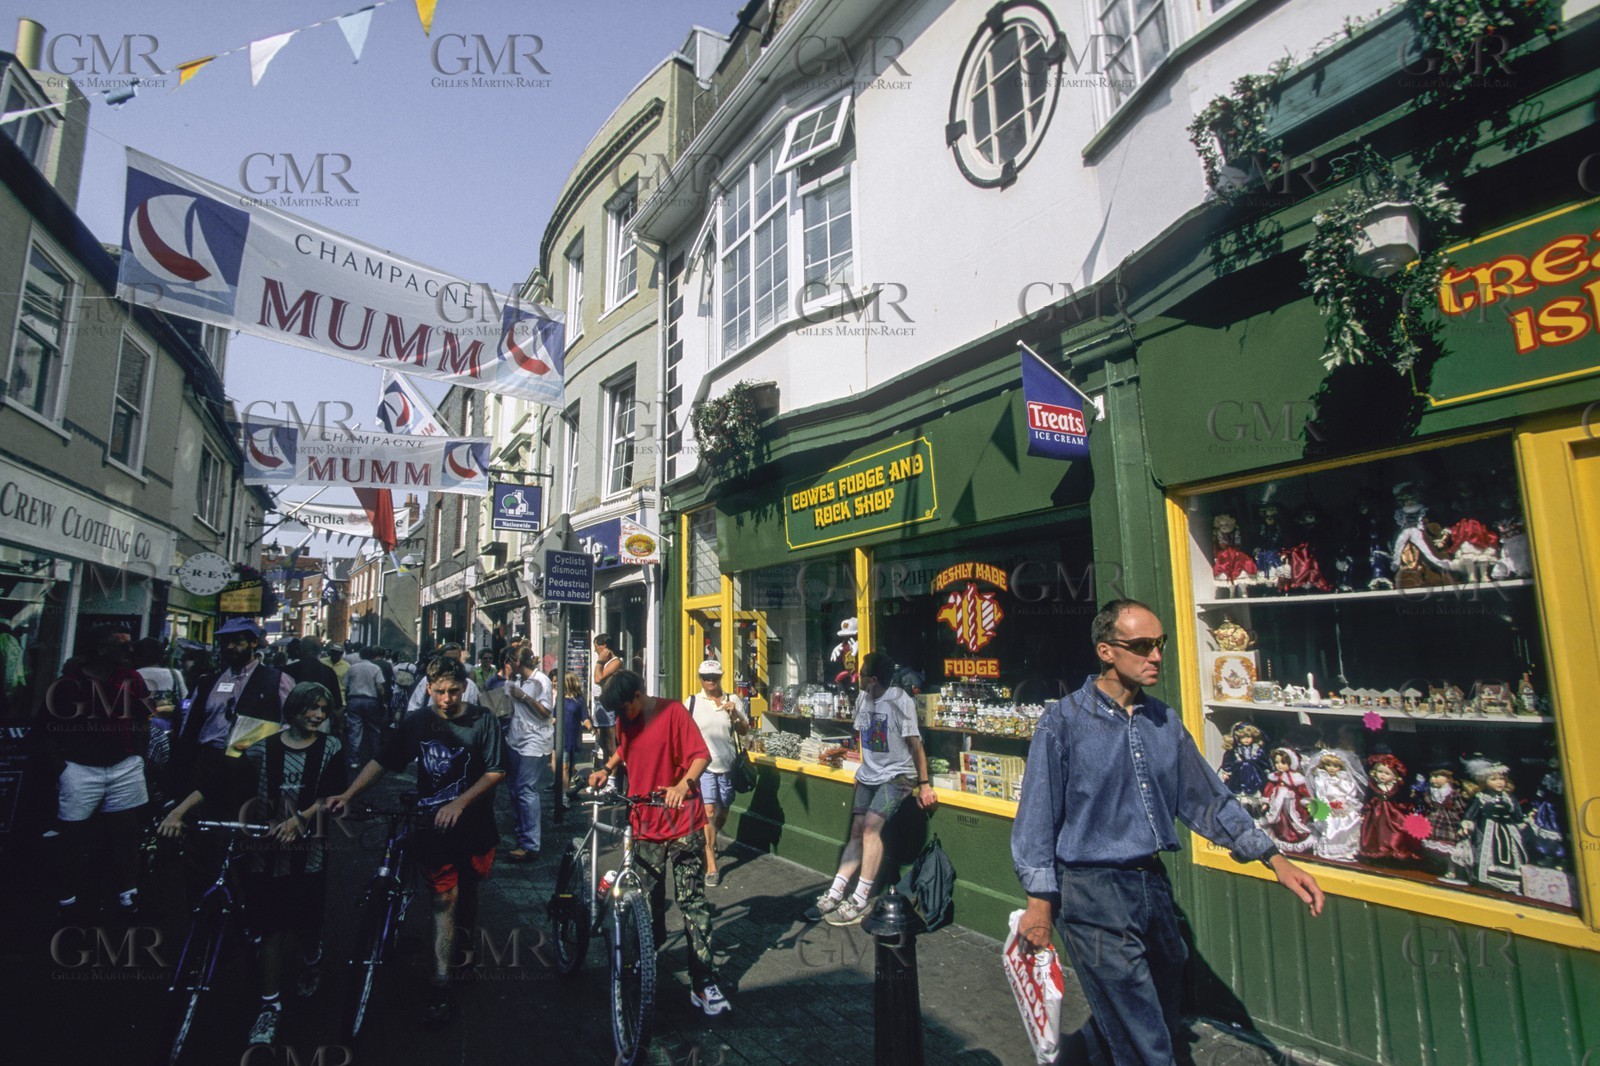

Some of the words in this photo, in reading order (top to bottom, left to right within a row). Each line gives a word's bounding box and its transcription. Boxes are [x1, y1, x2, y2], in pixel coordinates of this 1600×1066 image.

[295, 233, 475, 309] CHAMPAGNE
[256, 276, 486, 379] MUMM
[1029, 404, 1084, 433] Treats
[320, 431, 426, 449] CHAMPAGNE
[1035, 431, 1051, 441] ICE
[1054, 434, 1084, 445] CREAM
[307, 456, 432, 487] MUMM
[791, 482, 836, 511] COWES
[838, 465, 885, 497] FUDGE
[889, 453, 924, 482] AND
[814, 500, 851, 527] ROCK
[854, 487, 895, 516] SHOP
[0, 481, 57, 530] CREW
[62, 506, 132, 554] CLOTHING
[134, 532, 151, 560] CO
[502, 520, 532, 529] Nationwide
[551, 566, 588, 576] dismount
[554, 554, 586, 566] Cyclists
[548, 577, 590, 589] Pedestrian
[930, 562, 974, 596] FRESHLY
[975, 562, 1008, 592] MADE
[547, 589, 566, 597] area
[567, 588, 590, 599] ahead
[944, 659, 999, 677] FUDGE
